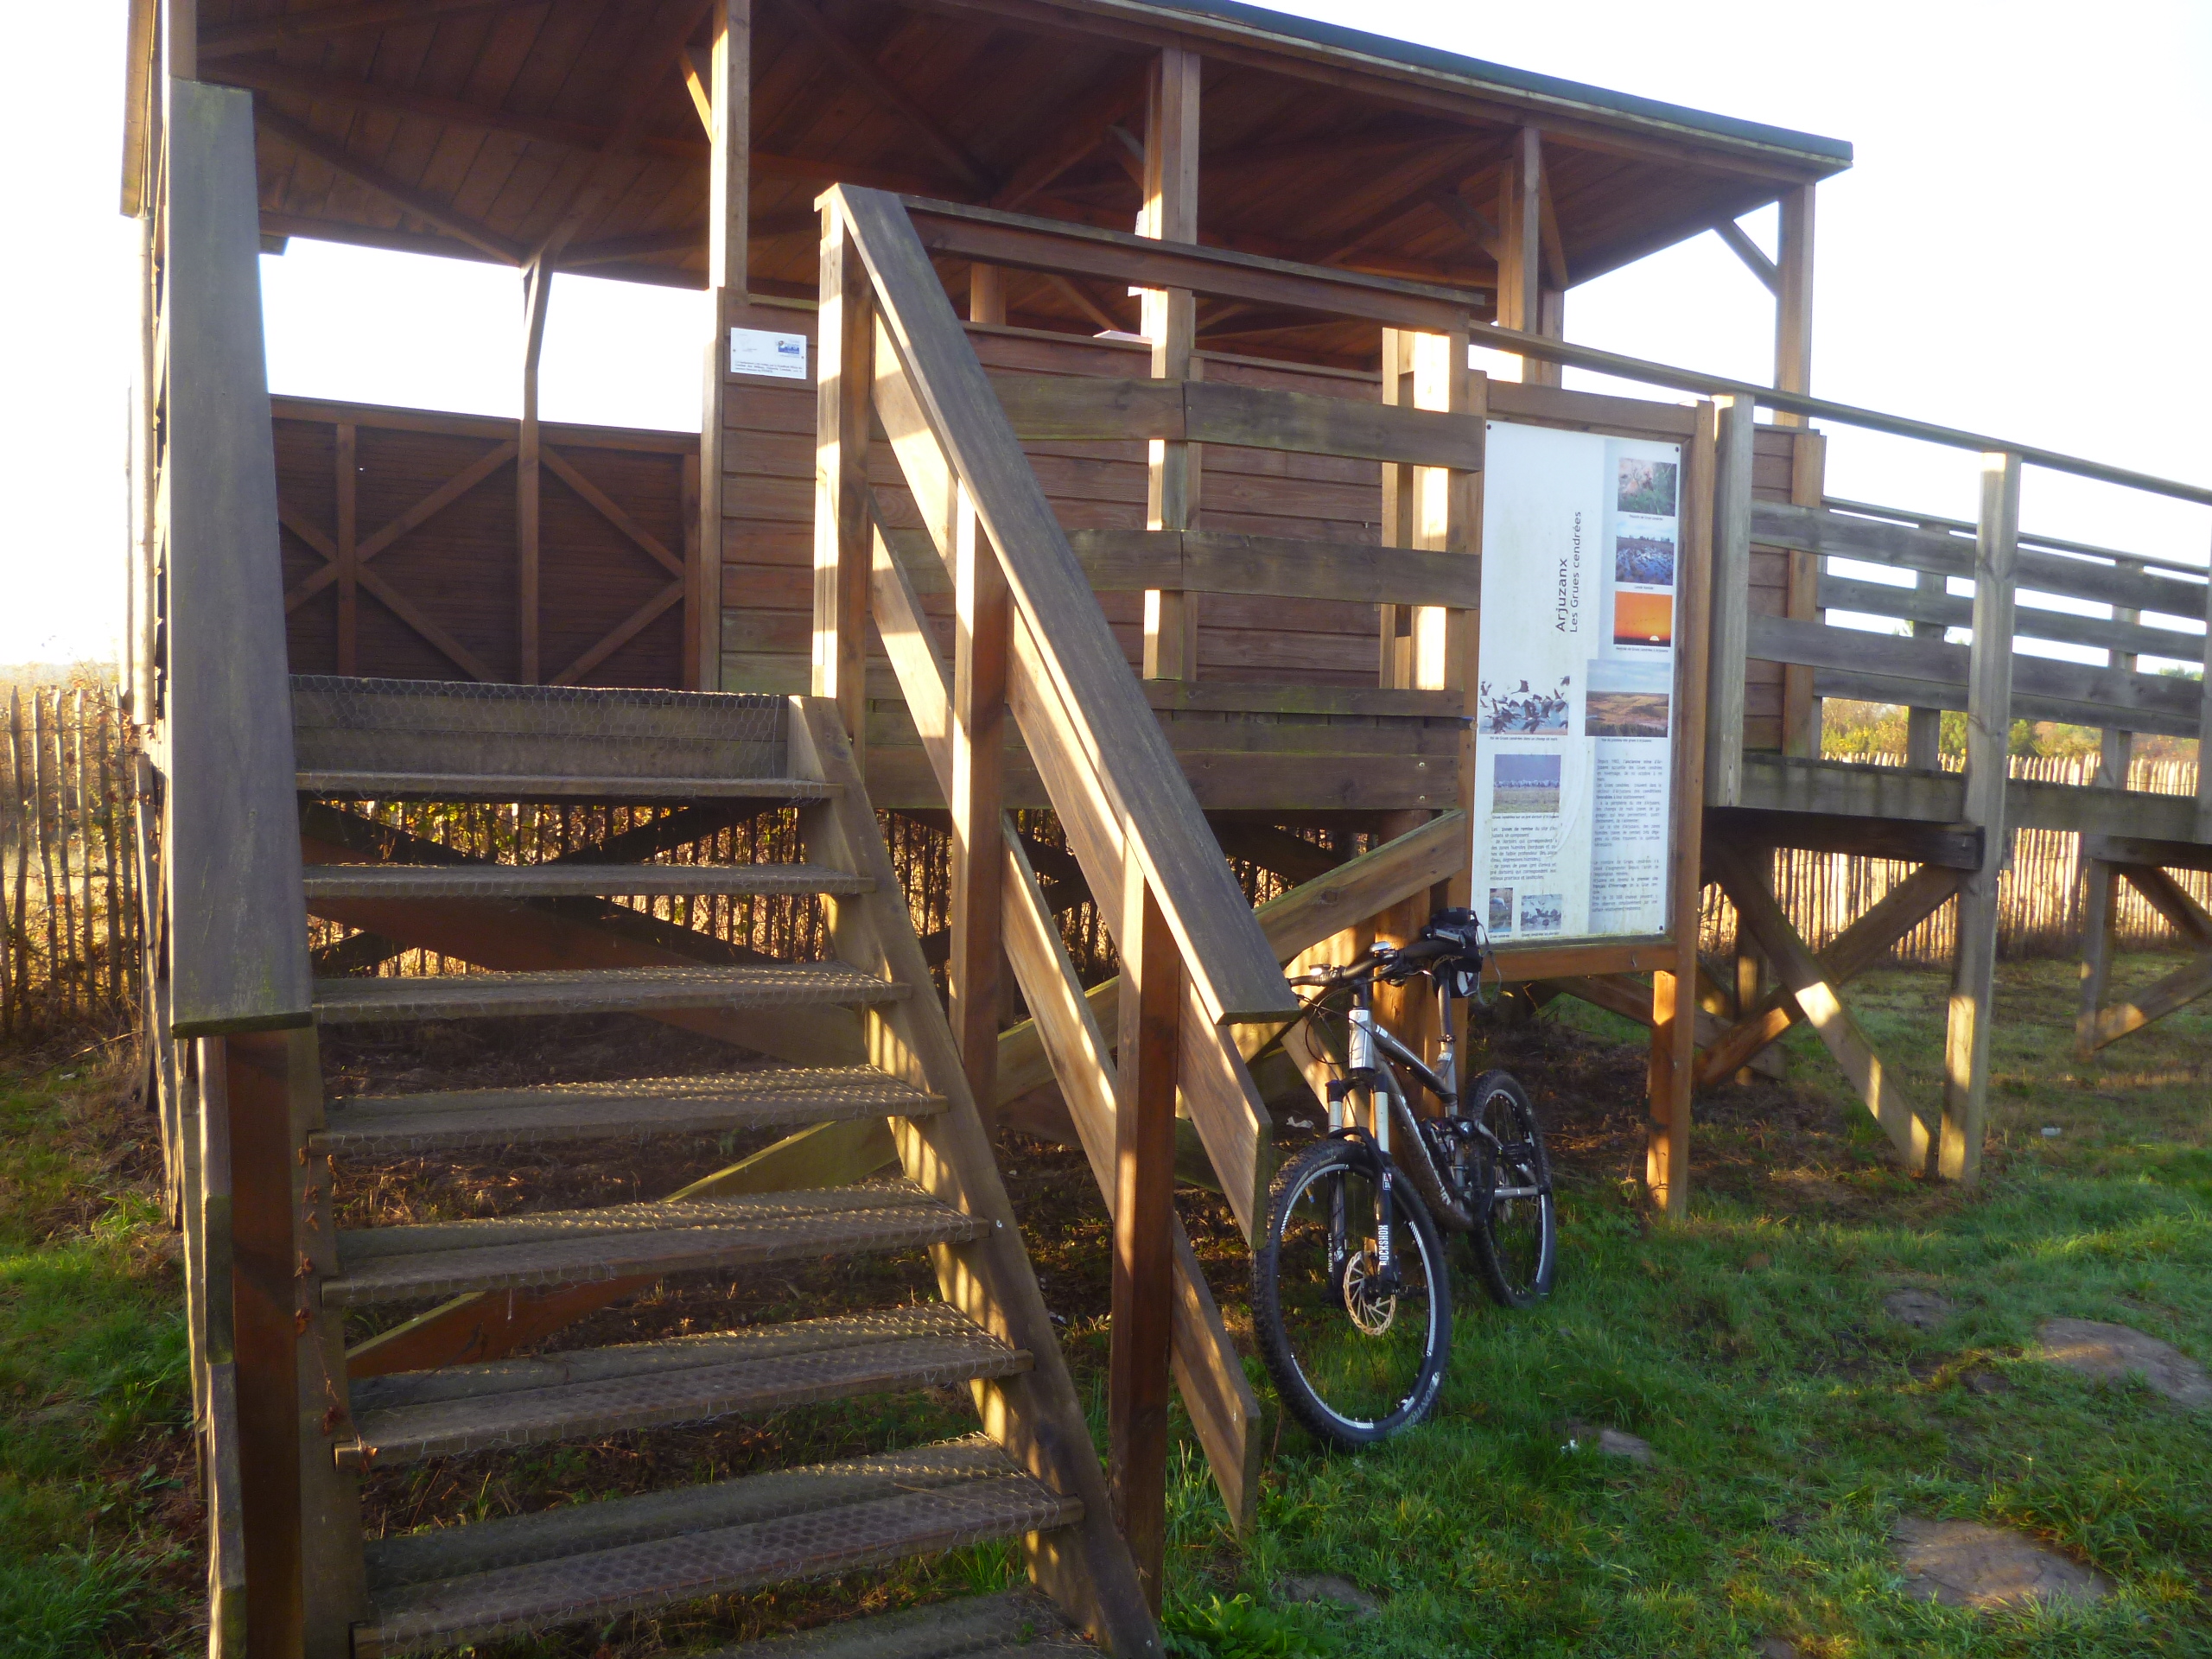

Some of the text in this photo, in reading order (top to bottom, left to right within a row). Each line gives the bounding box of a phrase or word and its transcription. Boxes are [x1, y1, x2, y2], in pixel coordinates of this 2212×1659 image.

[1555, 557, 1568, 632] Arjuzanx
[1569, 511, 1581, 632] Les Grues cendrées
[1378, 1224, 1389, 1267] ROCKSHOX
